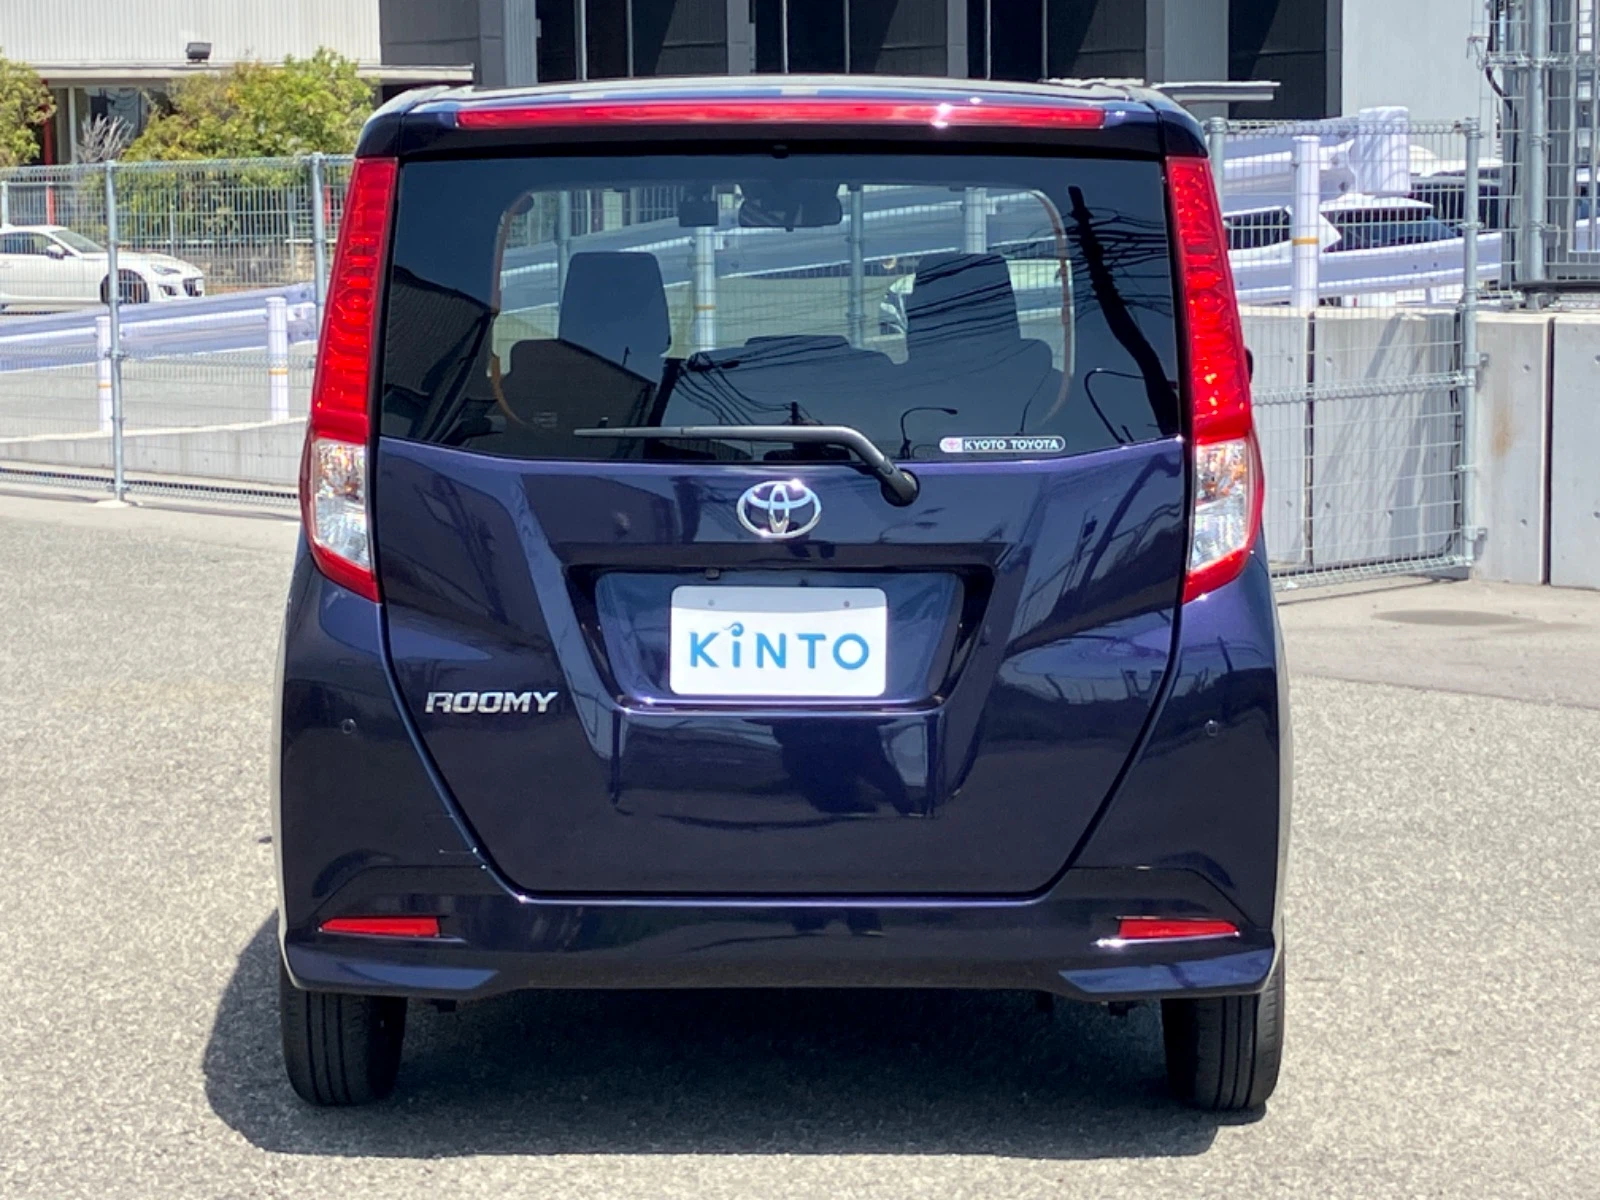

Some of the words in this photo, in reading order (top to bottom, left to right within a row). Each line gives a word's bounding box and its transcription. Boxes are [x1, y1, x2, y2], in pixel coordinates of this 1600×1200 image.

[964, 440, 1006, 450] KYOTO
[1010, 440, 1059, 450] TOYOTA
[425, 692, 558, 713] ROOMY
